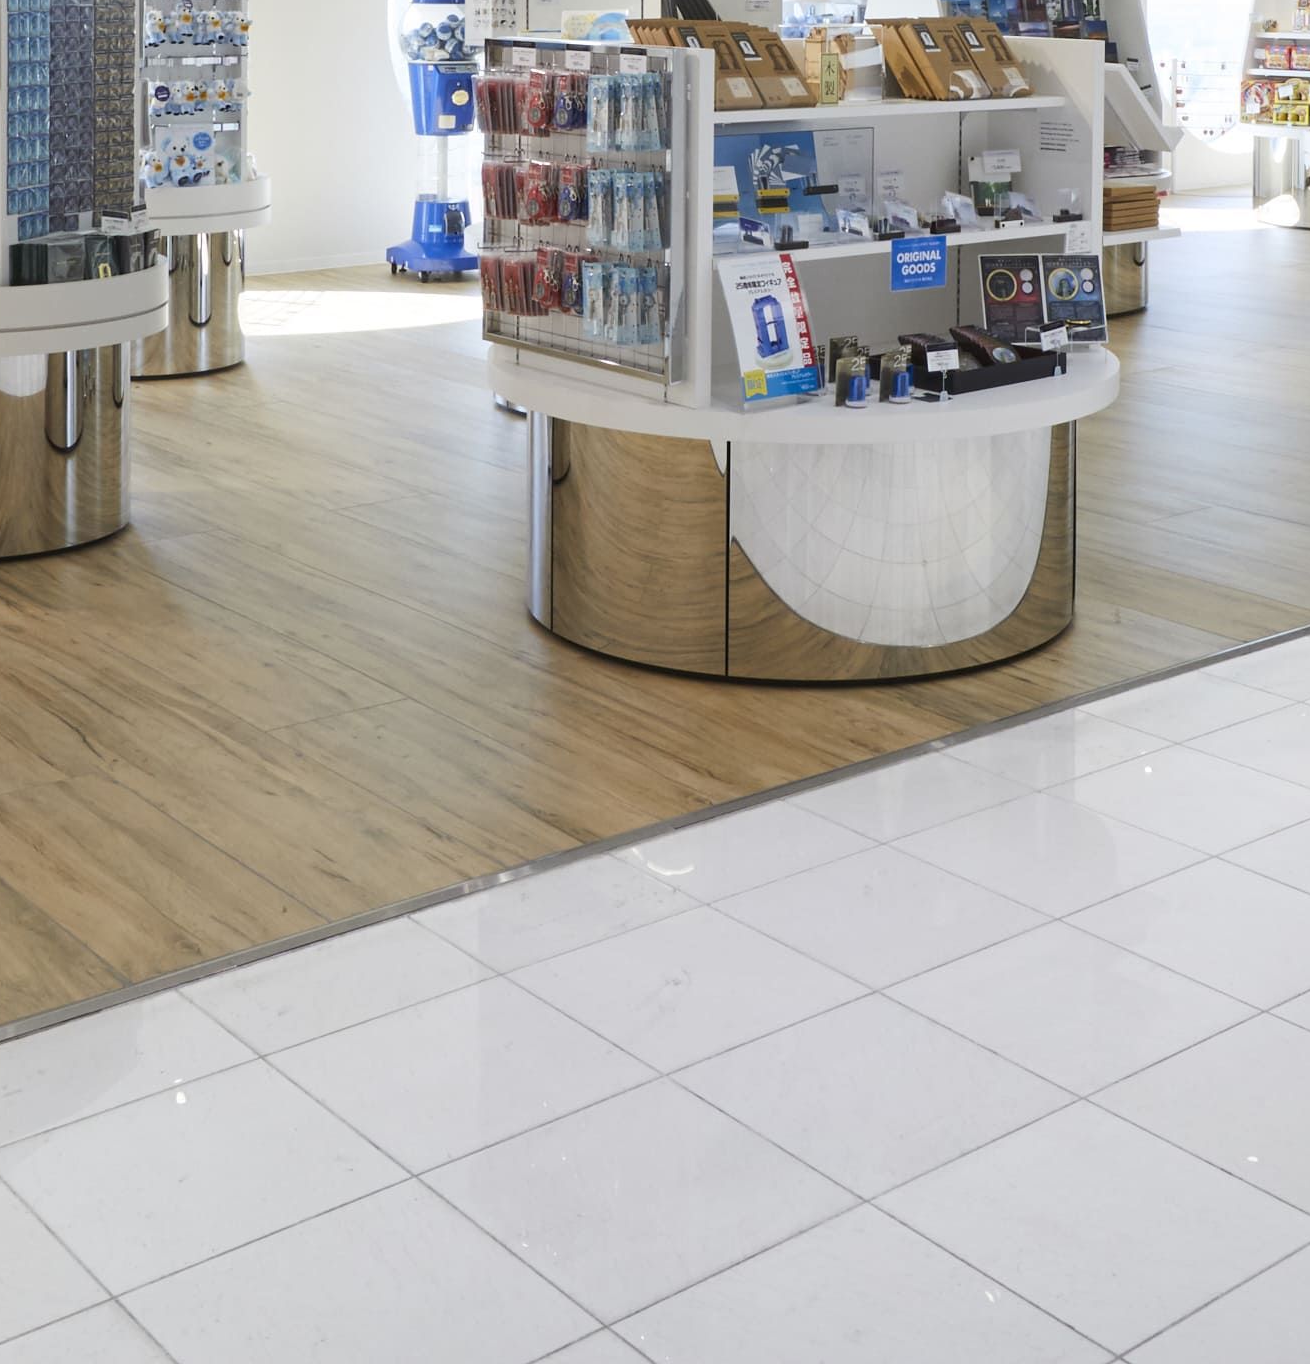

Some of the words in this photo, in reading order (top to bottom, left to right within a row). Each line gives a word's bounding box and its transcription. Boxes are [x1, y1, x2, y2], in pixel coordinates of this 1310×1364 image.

[896, 249, 942, 264] ORIGINAL
[901, 262, 936, 276] GOODS
[851, 357, 866, 371] 25
